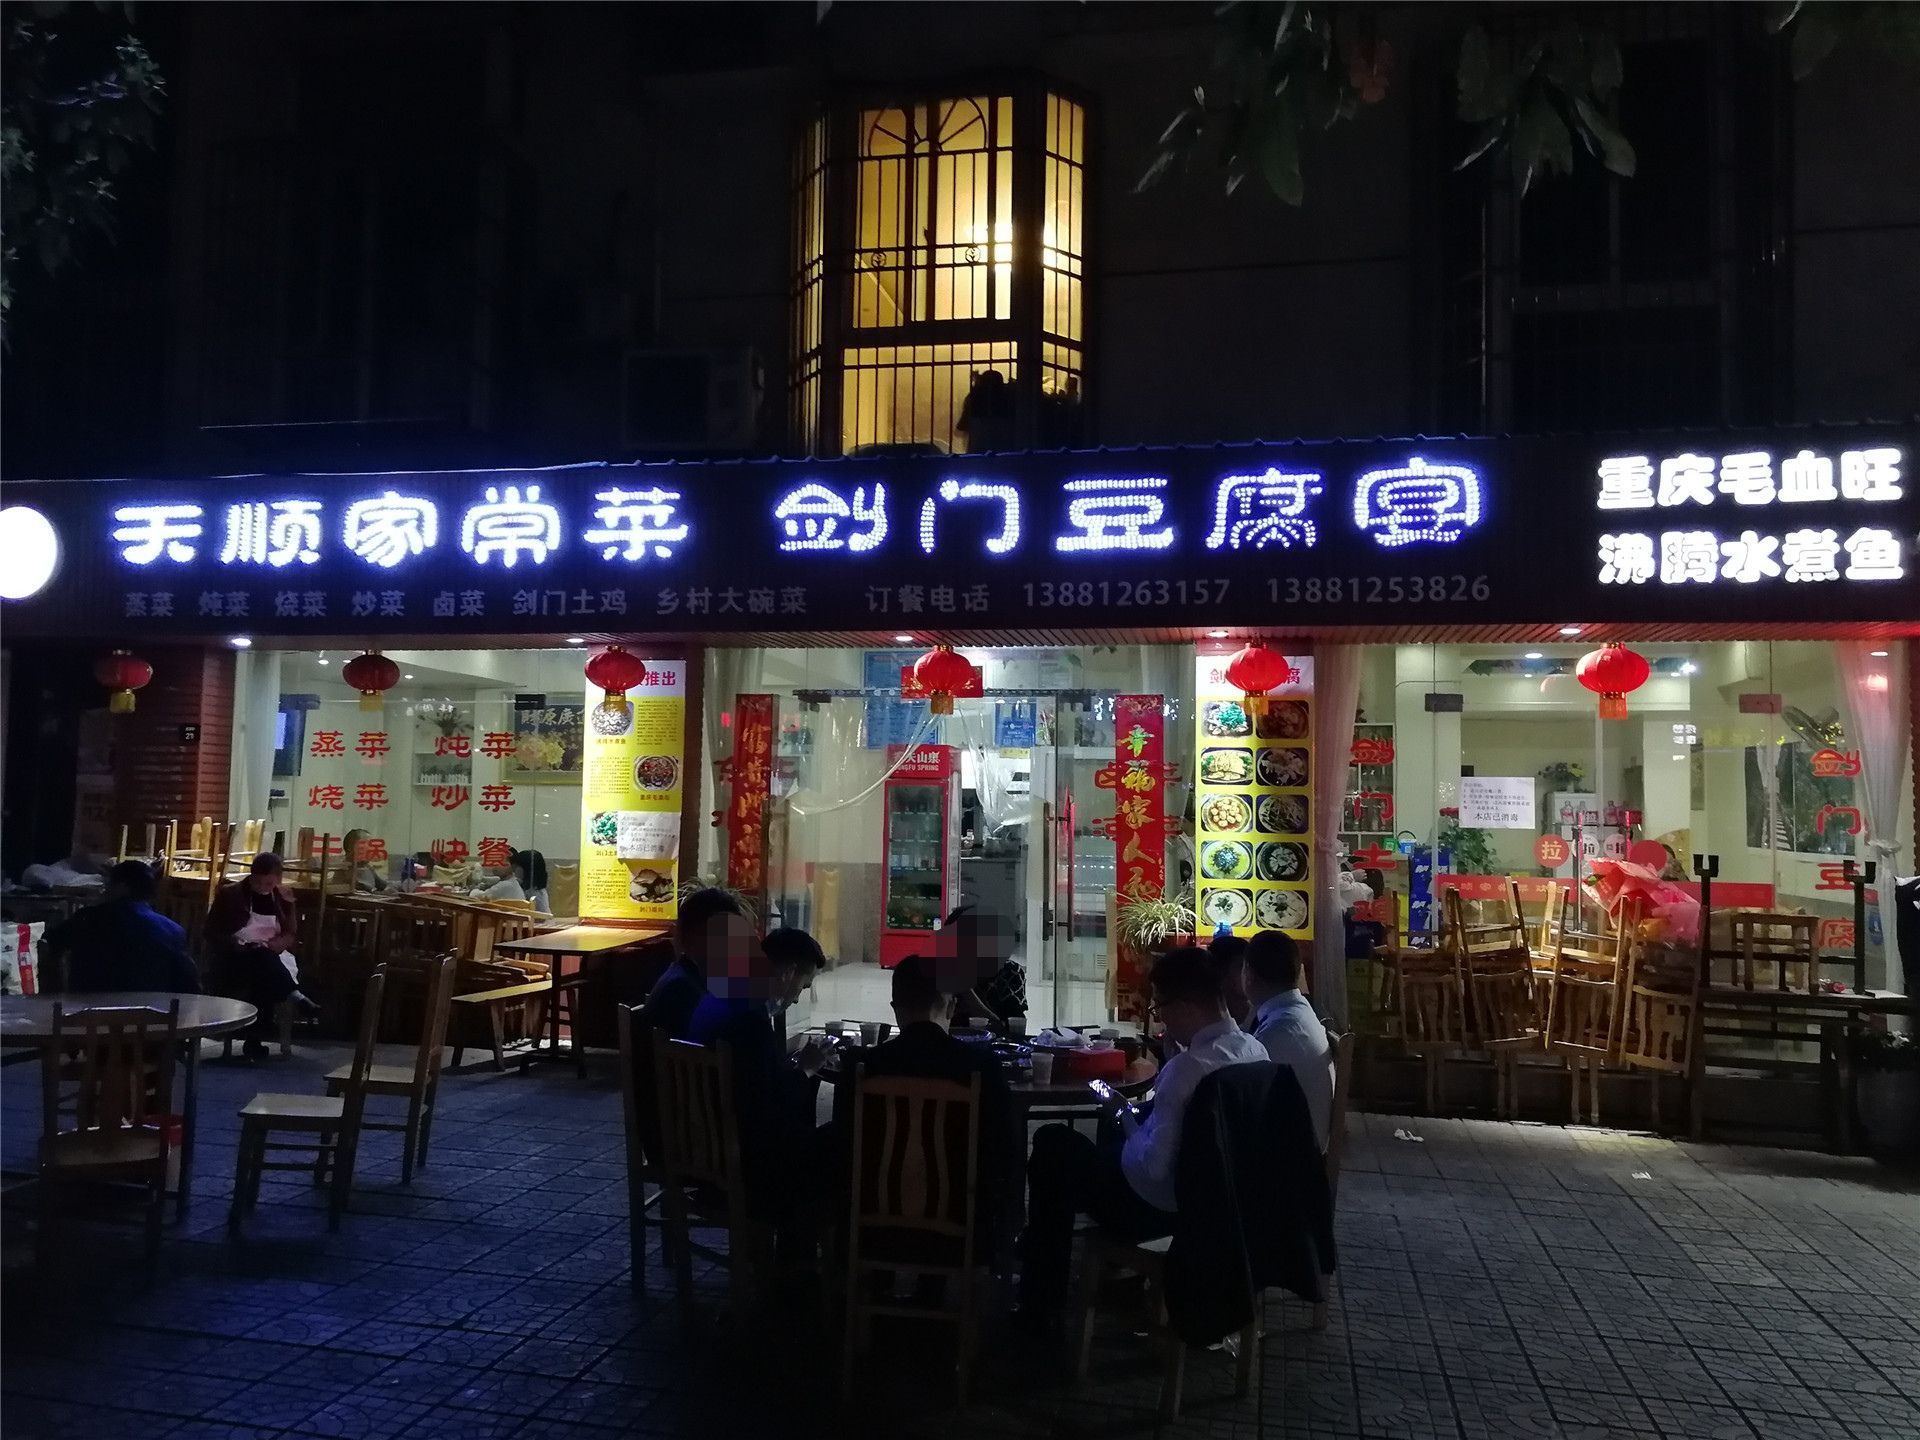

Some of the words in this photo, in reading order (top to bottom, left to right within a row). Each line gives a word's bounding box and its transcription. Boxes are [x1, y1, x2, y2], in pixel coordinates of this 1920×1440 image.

[1597, 448, 1903, 510] 重庆毛血旺
[113, 486, 689, 568] 天顺家常菜
[774, 457, 1481, 553] 剑门豆腐宴
[1598, 527, 1904, 584] 沸腾水煮鱼
[125, 591, 174, 617] 蒸菜
[198, 591, 250, 617] 炖菜
[275, 591, 327, 617] 烧菜
[352, 590, 405, 617] 炒菜
[433, 589, 485, 616] 卤菜
[513, 588, 627, 616] 剑门土鸡
[656, 587, 807, 615] 乡村大碗菜
[864, 585, 990, 613] 订餐电话
[1023, 579, 1230, 607] 13881263157
[1267, 574, 1490, 603] 13881253826
[311, 731, 390, 758] 蒸菜
[434, 733, 517, 759] 炖菜
[309, 784, 389, 811] 烧菜
[432, 785, 516, 813] 炒菜
[431, 837, 513, 868] 快餐
[1541, 840, 1562, 860] 拉
